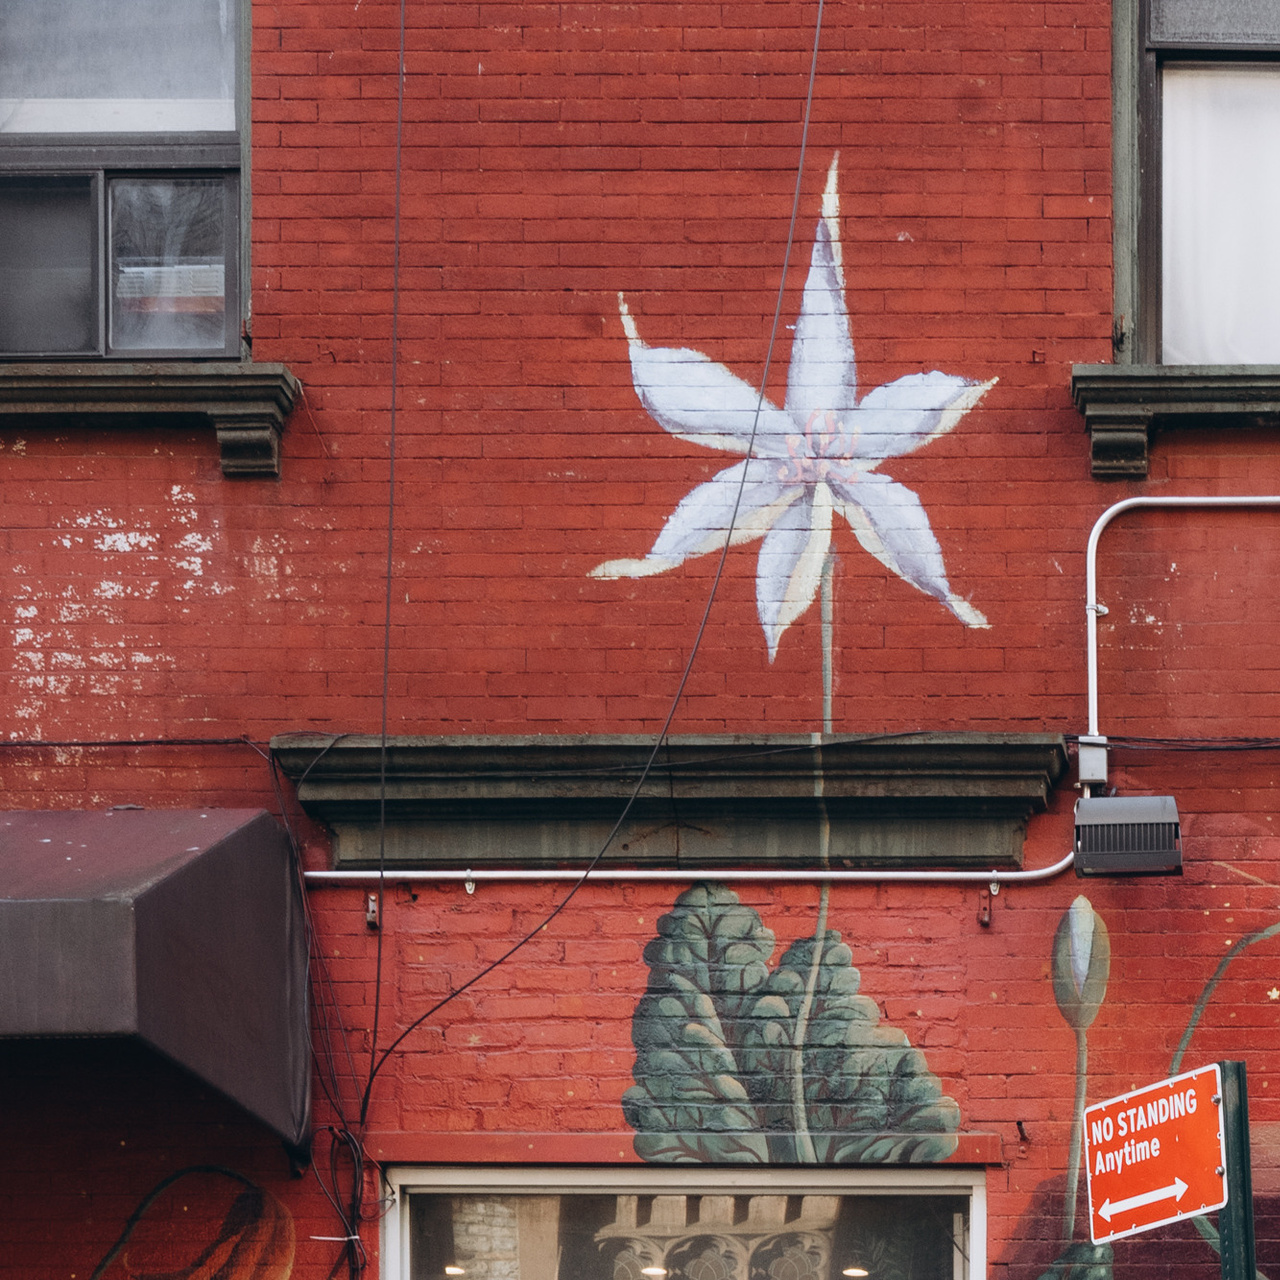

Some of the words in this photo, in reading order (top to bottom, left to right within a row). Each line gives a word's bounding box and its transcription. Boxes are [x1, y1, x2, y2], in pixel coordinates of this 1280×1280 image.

[1091, 1116, 1114, 1145] NO
[1117, 1089, 1198, 1137] STANDING
[1095, 1137, 1161, 1175] Anytime
